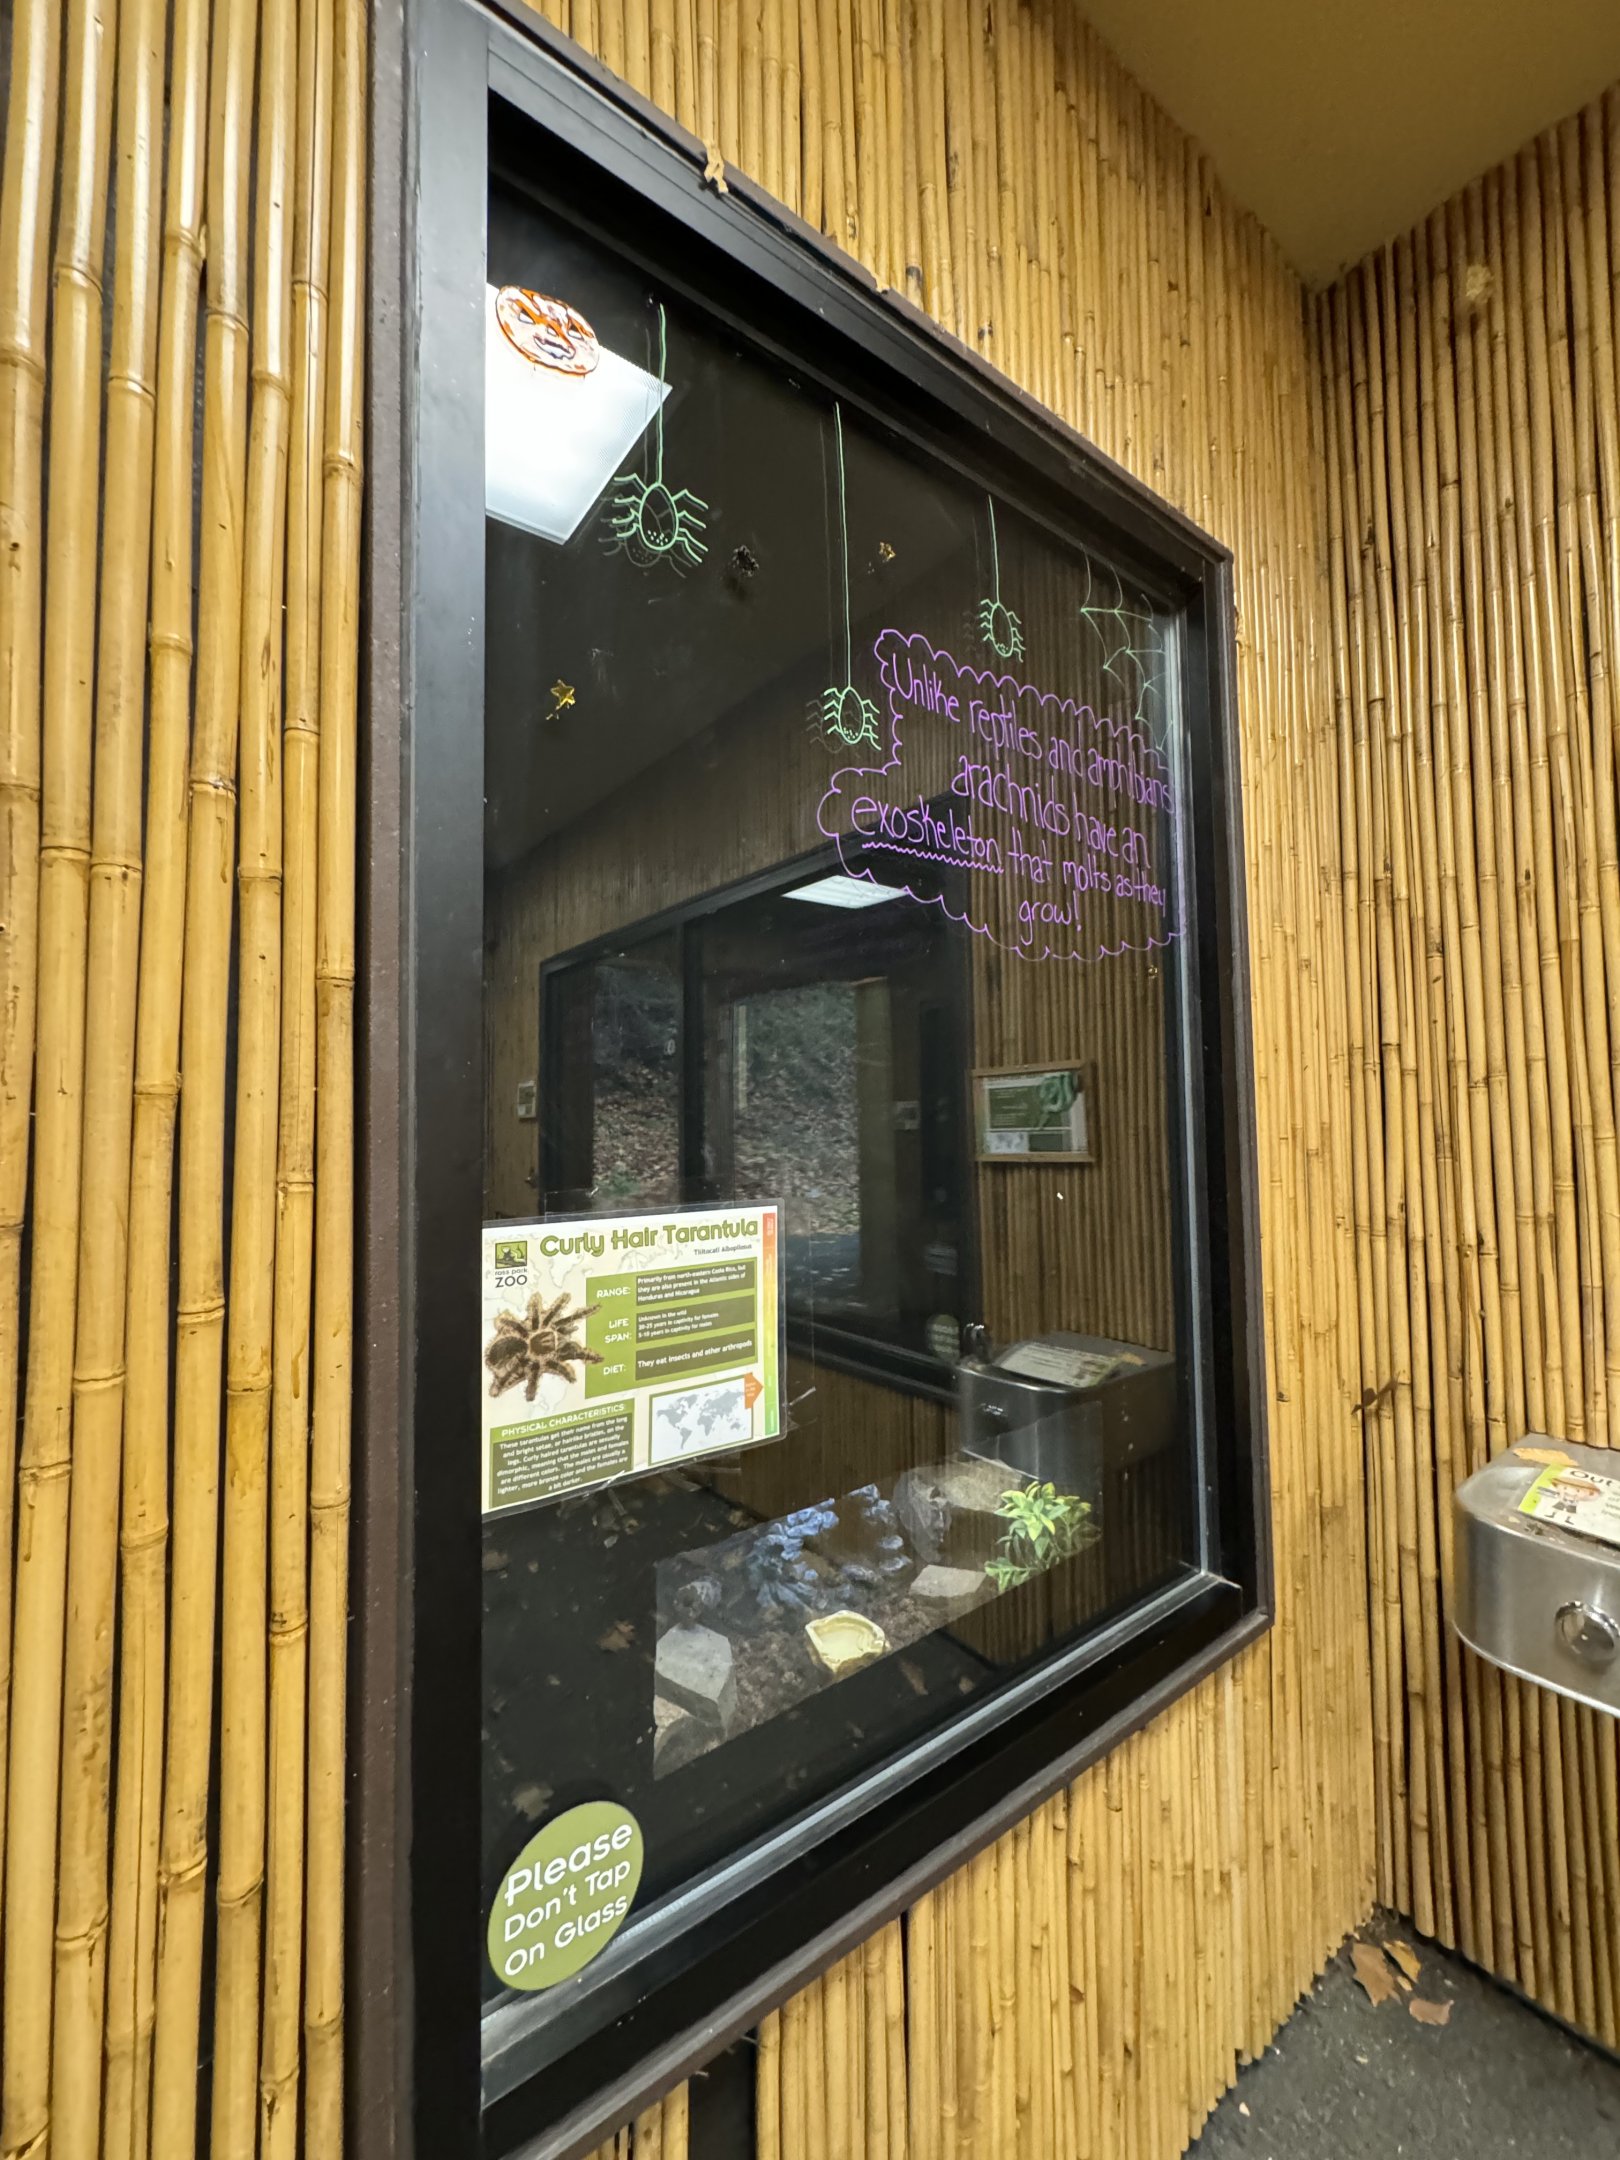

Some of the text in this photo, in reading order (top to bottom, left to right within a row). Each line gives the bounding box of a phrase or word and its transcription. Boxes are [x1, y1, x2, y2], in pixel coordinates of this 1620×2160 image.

[893, 652, 960, 722] Unlike
[969, 694, 1043, 761] reptiles
[1048, 719, 1083, 777] and
[951, 755, 1151, 869] arachnids have an
[851, 795, 1003, 864] exoskeleton
[1008, 826, 1054, 883] that
[1062, 853, 1113, 892] molts
[1019, 890, 1082, 946] grow!
[540, 1232, 605, 1257] Curly
[611, 1227, 658, 1250] Hair
[662, 1218, 758, 1244] Tarantula
[495, 1275, 528, 1288] ZOO
[663, 1273, 676, 1281] from
[597, 1286, 631, 1299] RANGE:
[608, 1318, 629, 1329] LIFE
[604, 1331, 632, 1344] SPAN:
[637, 1339, 753, 1368] They eat insects and other arthropods
[603, 1363, 626, 1375] DIET:
[502, 1403, 625, 1437] PHYSICAL CHARACTERISTICS
[500, 1441, 518, 1449] These
[519, 1435, 550, 1446] tarantulas
[550, 1433, 560, 1441] get
[561, 1428, 574, 1437] their
[576, 1425, 591, 1433] name
[591, 1421, 605, 1429] from
[502, 1450, 515, 1458] and
[516, 1446, 535, 1456] bright
[523, 1454, 540, 1463] Curly
[570, 1451, 579, 1459] the
[597, 1444, 607, 1452] and
[500, 1477, 511, 1485] are
[512, 1471, 540, 1483] different
[563, 1461, 574, 1469] The
[521, 1480, 538, 1489] more
[575, 1467, 586, 1475] and
[586, 1463, 596, 1471] the
[504, 1823, 633, 1908] Please
[504, 1861, 631, 1943] Don't Tap
[504, 1895, 628, 1977] On Glass
